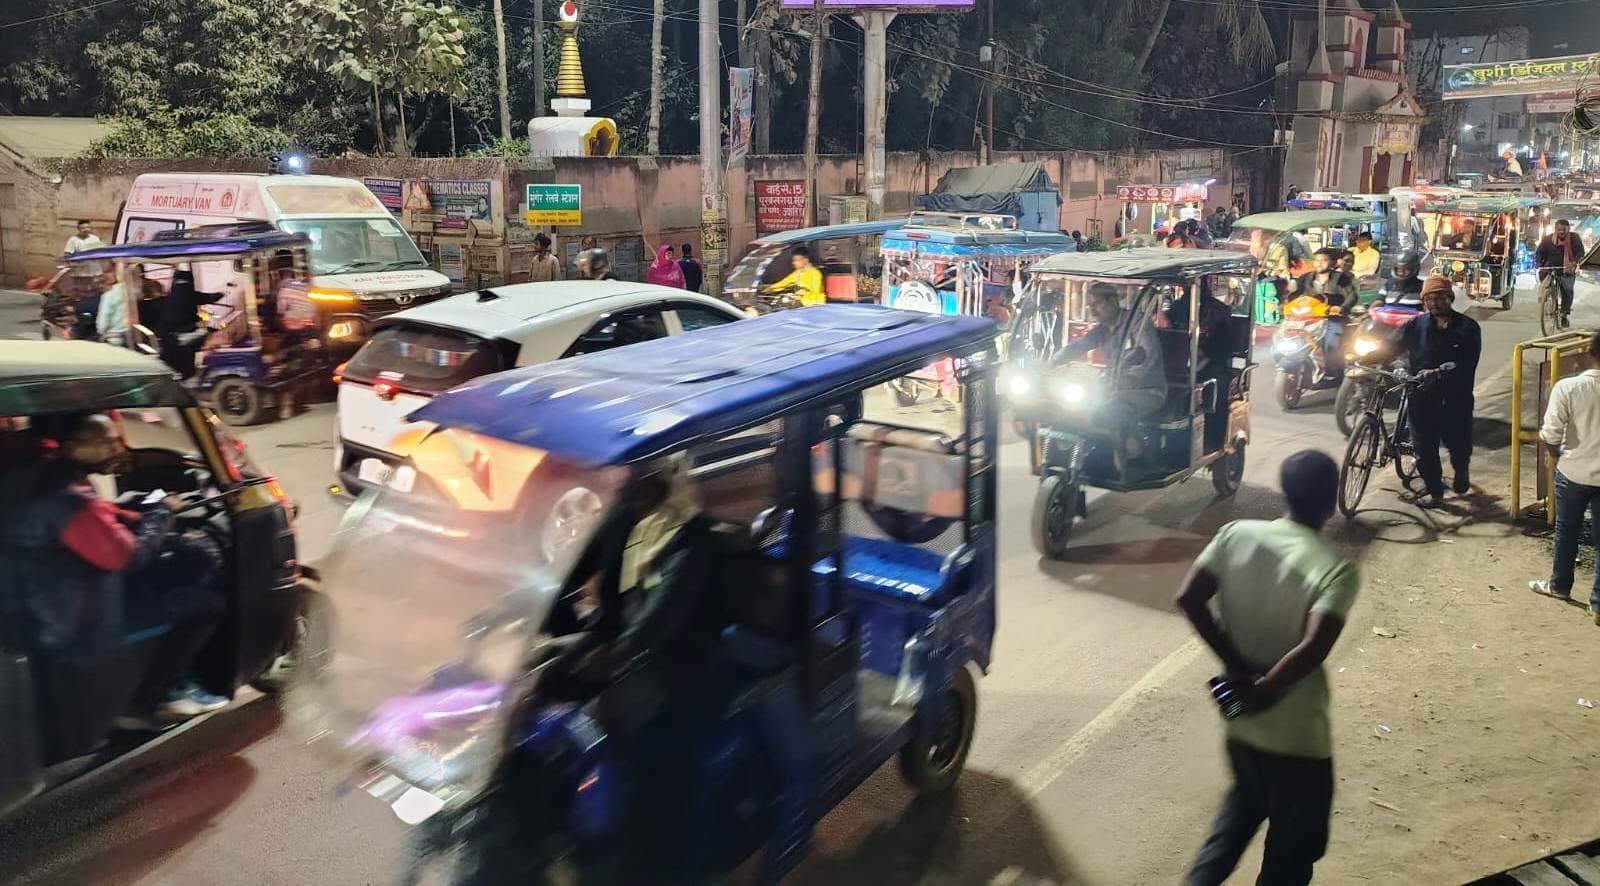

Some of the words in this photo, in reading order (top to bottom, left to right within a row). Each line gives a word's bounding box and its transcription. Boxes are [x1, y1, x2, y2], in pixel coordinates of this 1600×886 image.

[1473, 64, 1505, 82] खुशी
[1509, 60, 1567, 78] डिजिटल
[462, 182, 489, 195] CLASSES
[793, 184, 803, 195] 15
[151, 195, 193, 208] MORTUARY
[195, 197, 211, 209] VAN
[545, 190, 560, 204] रेलवे
[560, 190, 578, 204] स्टेशन
